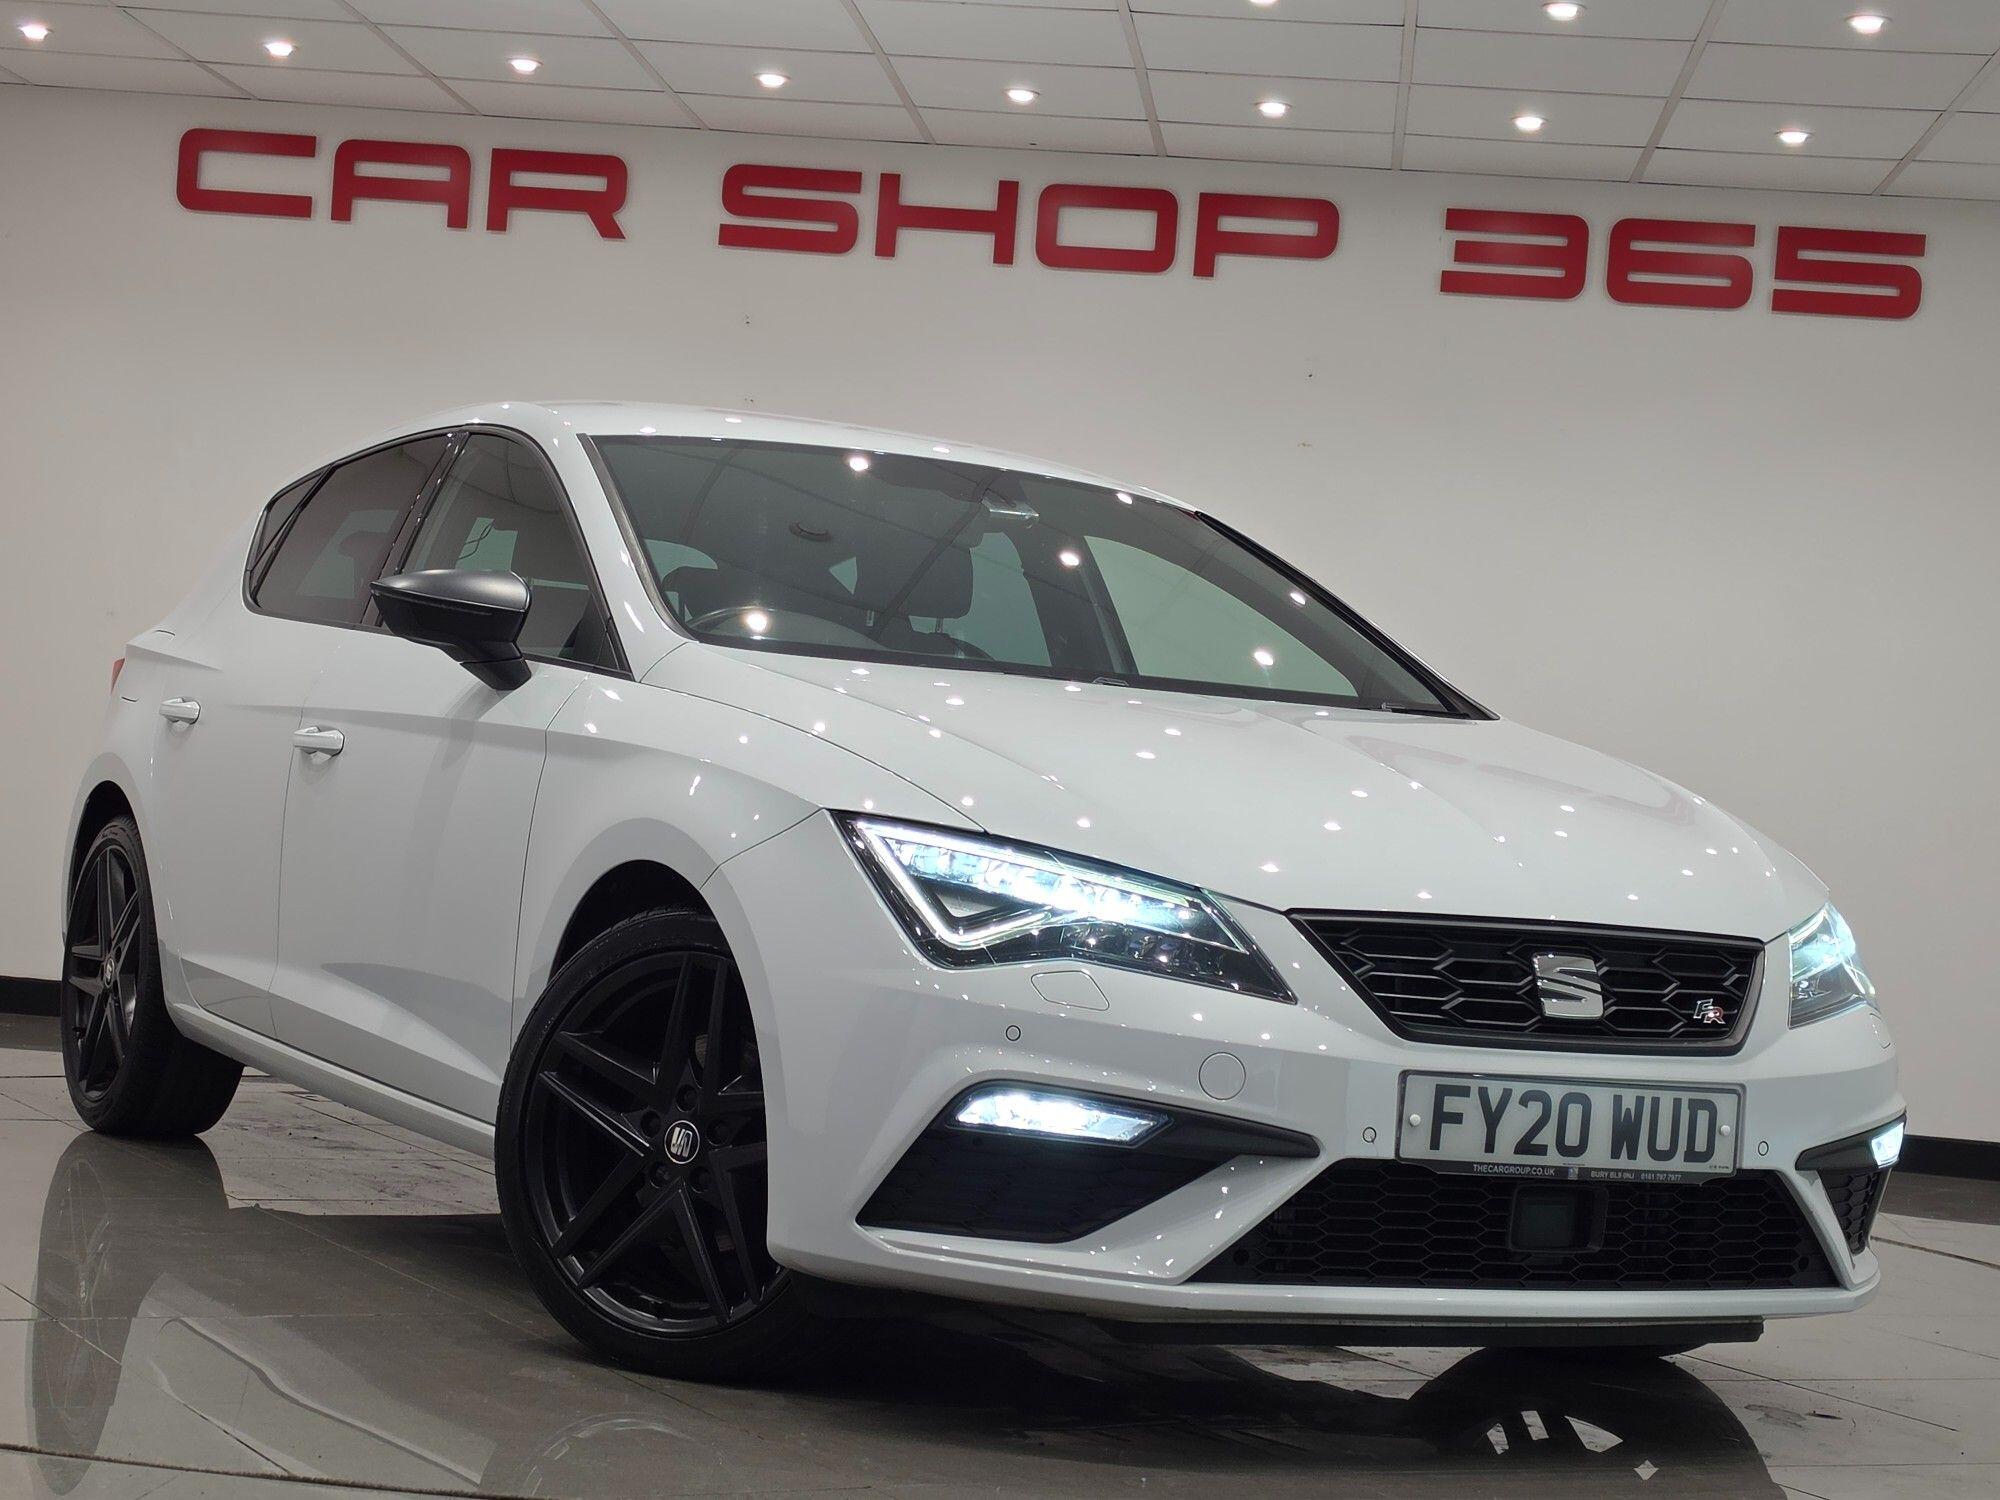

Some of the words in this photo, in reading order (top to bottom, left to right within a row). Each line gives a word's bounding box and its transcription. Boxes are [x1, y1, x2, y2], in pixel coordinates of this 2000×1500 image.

[177, 129, 628, 241] CAR
[718, 164, 1341, 279] SHOP
[1440, 208, 1925, 319] 365
[1692, 998, 1726, 1025] FR
[1428, 1083, 1593, 1159] FY20
[1610, 1093, 1719, 1164] WUD
[1472, 1163, 1556, 1176] THECARGROUP.CO.UK
